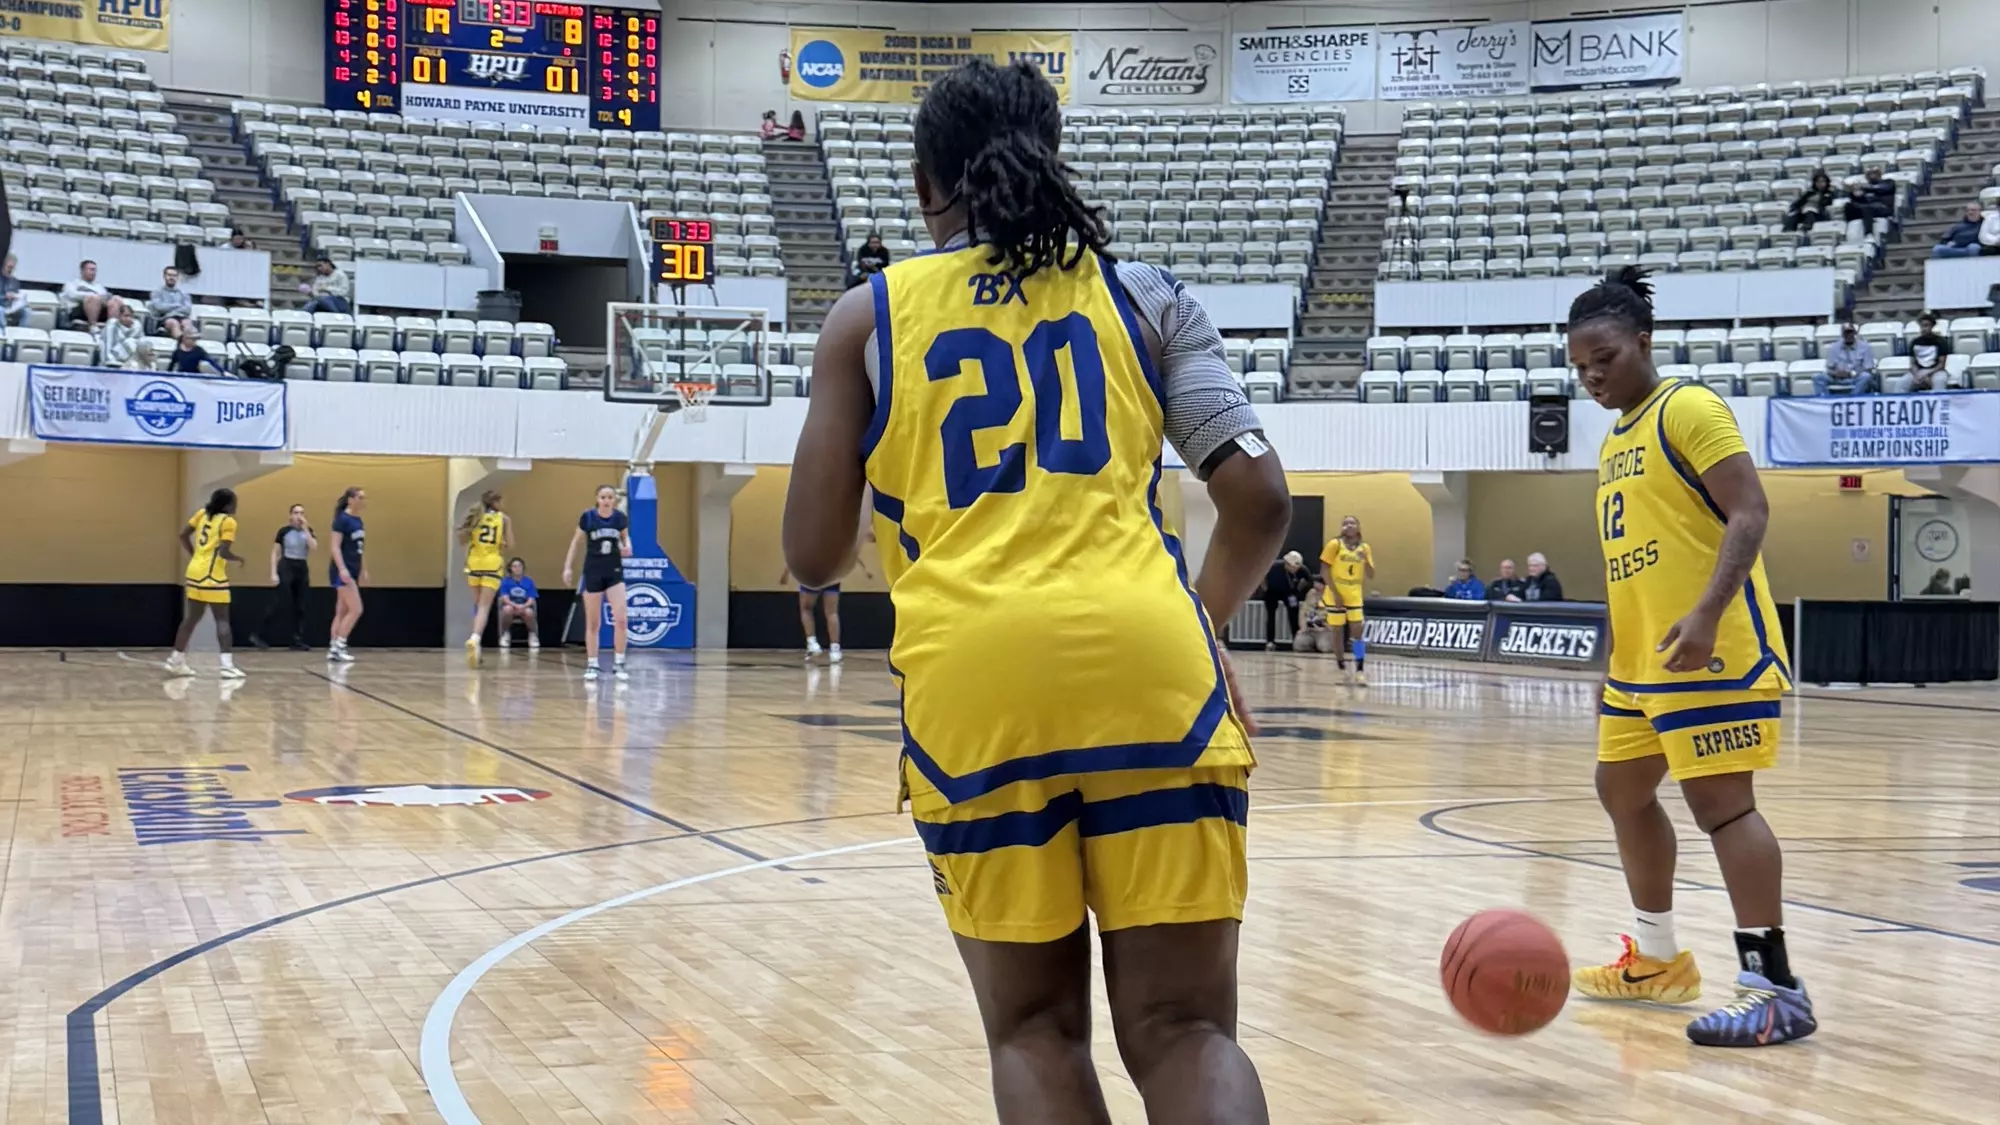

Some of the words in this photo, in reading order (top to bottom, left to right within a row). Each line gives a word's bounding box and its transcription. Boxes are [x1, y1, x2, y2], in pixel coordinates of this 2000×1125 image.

[426, 7, 450, 35] 19
[565, 18, 582, 45] 8
[490, 29, 504, 48] 2
[1456, 27, 1518, 60] Jerry's
[1579, 29, 1679, 62] BANK
[469, 53, 527, 76] HPU
[801, 62, 844, 77] NCAA
[1253, 49, 1353, 63] AGENCIES
[405, 95, 461, 109] HOWARD
[464, 98, 506, 113] PAYNE
[508, 103, 586, 119] UNIVERSITY
[618, 108, 632, 126] 4
[661, 243, 705, 280] 30
[968, 273, 1029, 306] BX
[44, 385, 64, 401] GET
[66, 386, 103, 403] READY
[924, 311, 1112, 510] 20
[1831, 401, 1866, 426] GET
[1872, 399, 1938, 426] READY
[1895, 426, 1949, 438] BASKETBALL
[1831, 440, 1949, 458] CHAMPIONSHIP
[1602, 490, 1625, 541] 12
[199, 524, 212, 546] 5
[479, 524, 498, 545] 21
[1608, 539, 1659, 582] RESS
[1362, 619, 1423, 646] OWARD
[1421, 621, 1486, 649] PAYNE
[1501, 622, 1600, 659] JACKETS
[1692, 722, 1762, 759] EXPRESS
